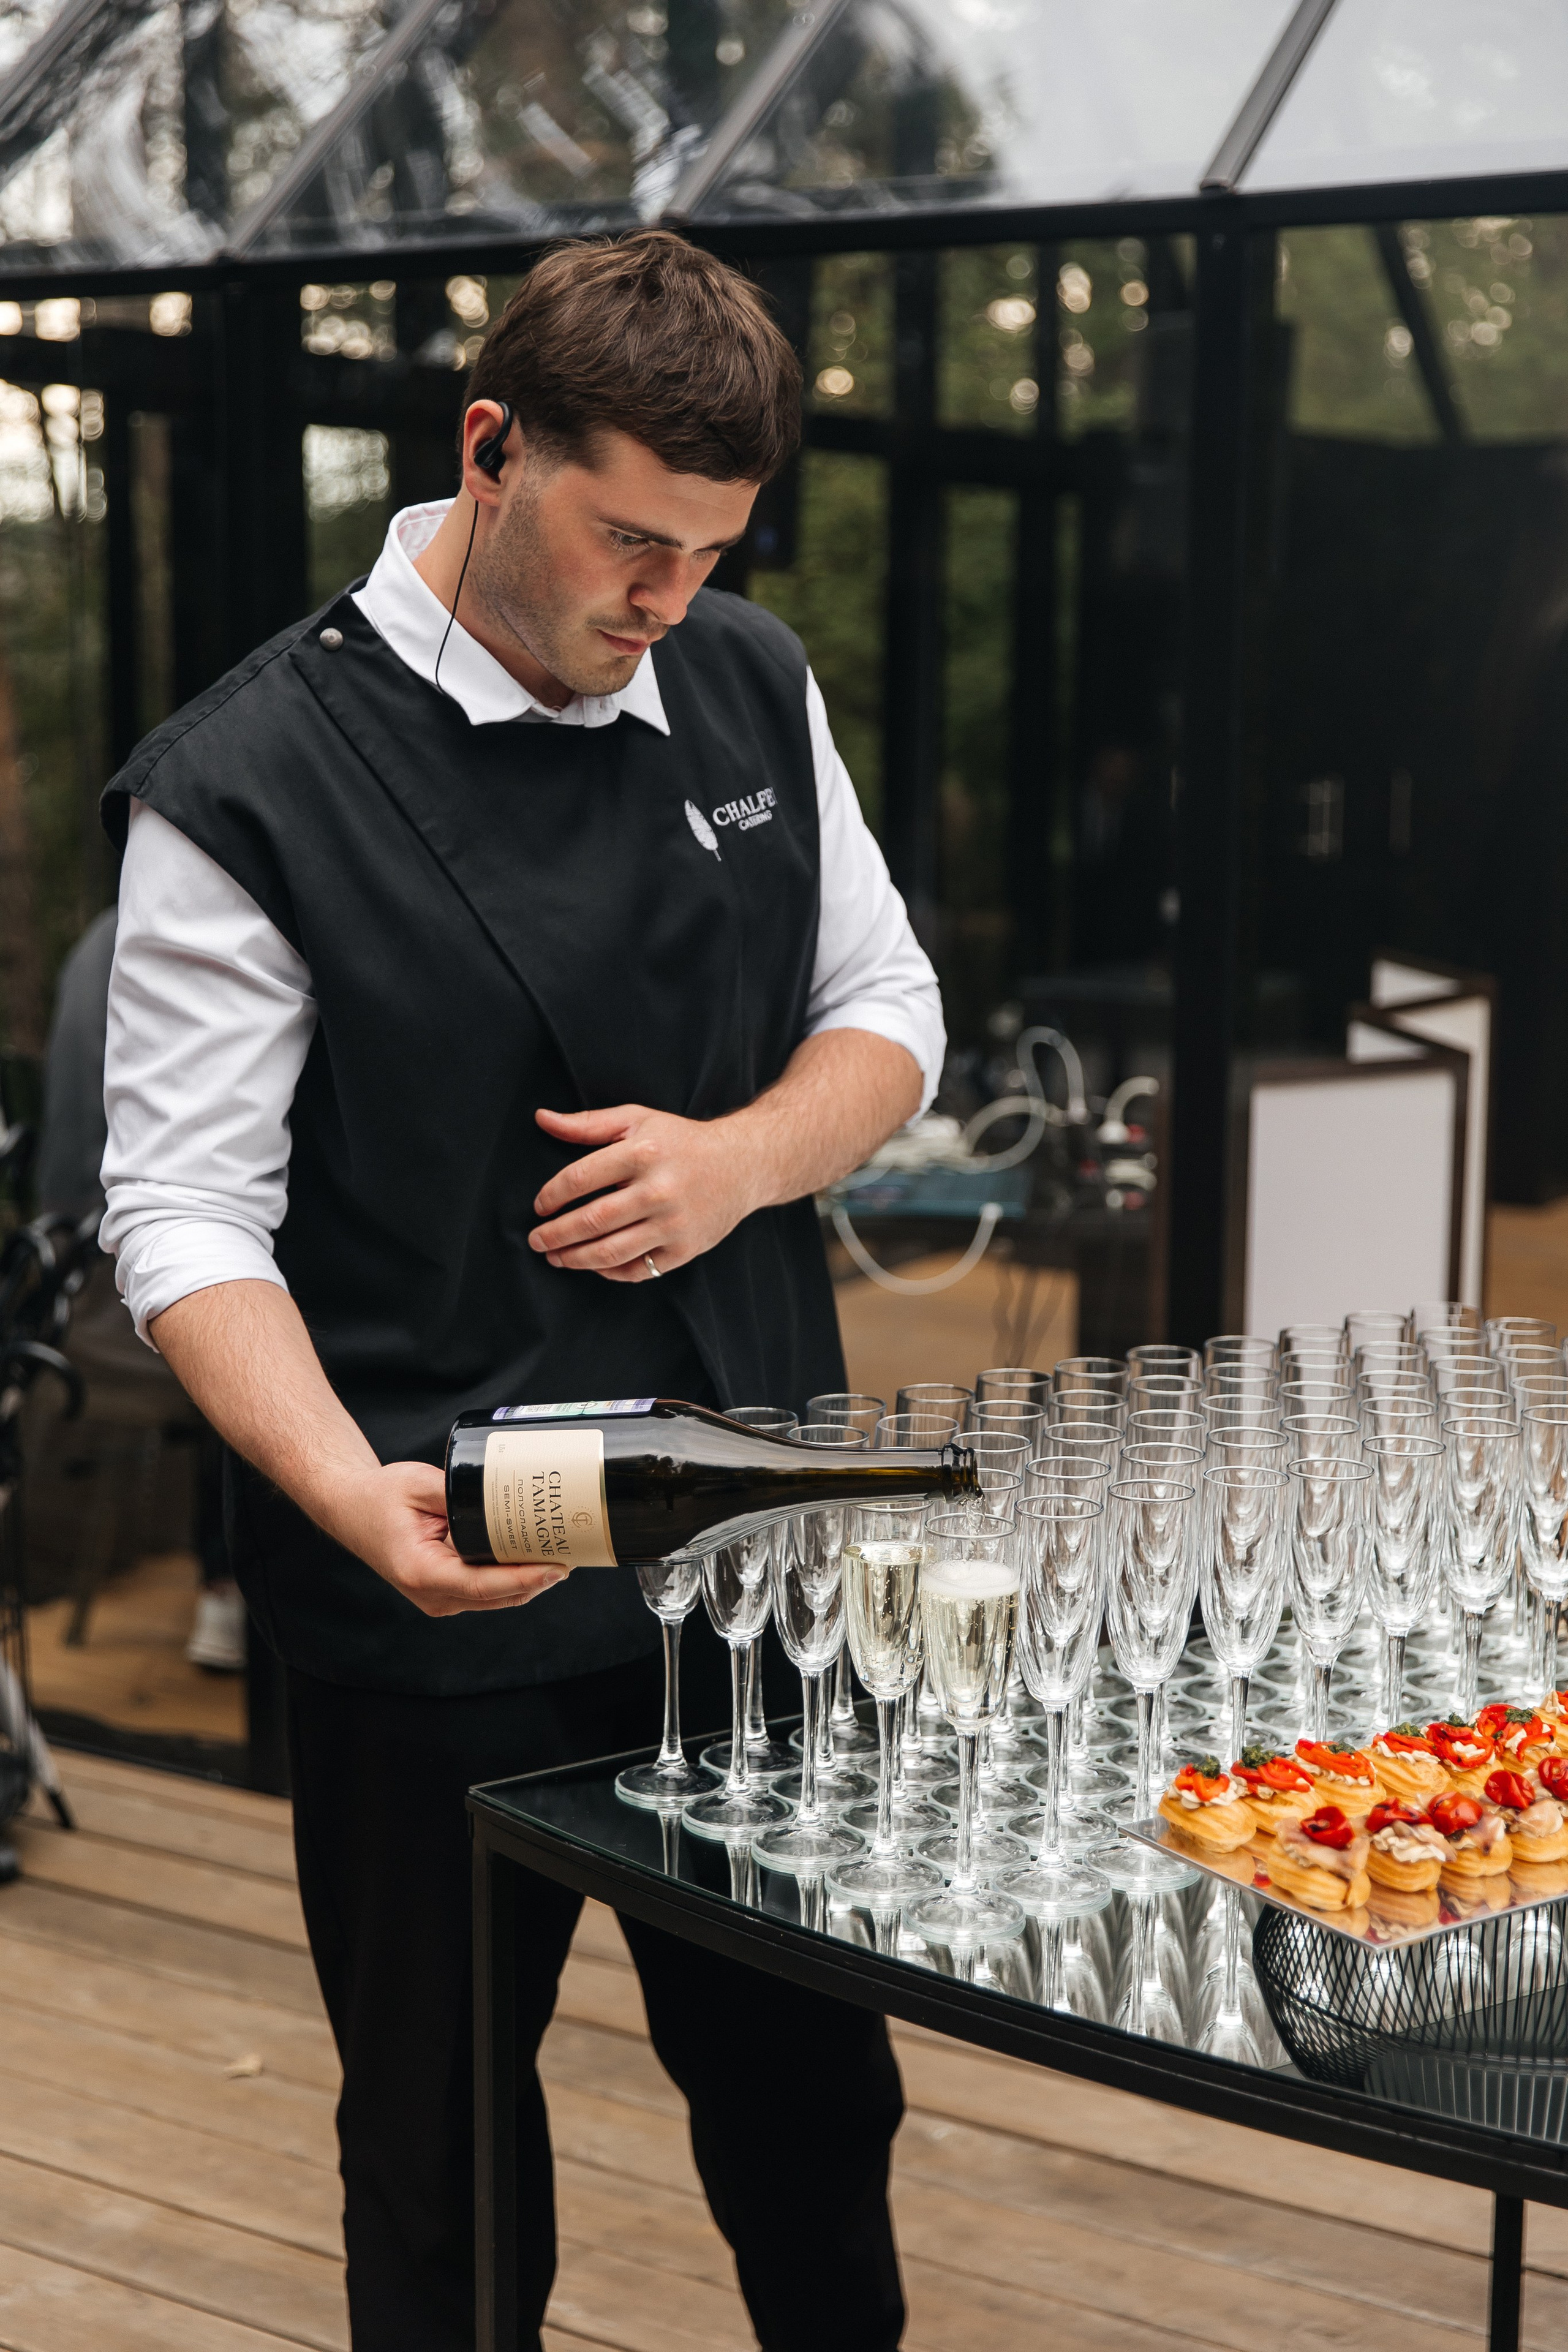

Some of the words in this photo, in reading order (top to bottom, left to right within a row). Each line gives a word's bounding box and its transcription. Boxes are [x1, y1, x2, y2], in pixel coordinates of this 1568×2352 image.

[503, 1484, 518, 1550] SEMI-SWEET
[518, 1479, 532, 1553] ПОЛУСЛАДКОЕ
[532, 1471, 554, 1557] TAMAGNE
[548, 1471, 571, 1556] CHATEAU
